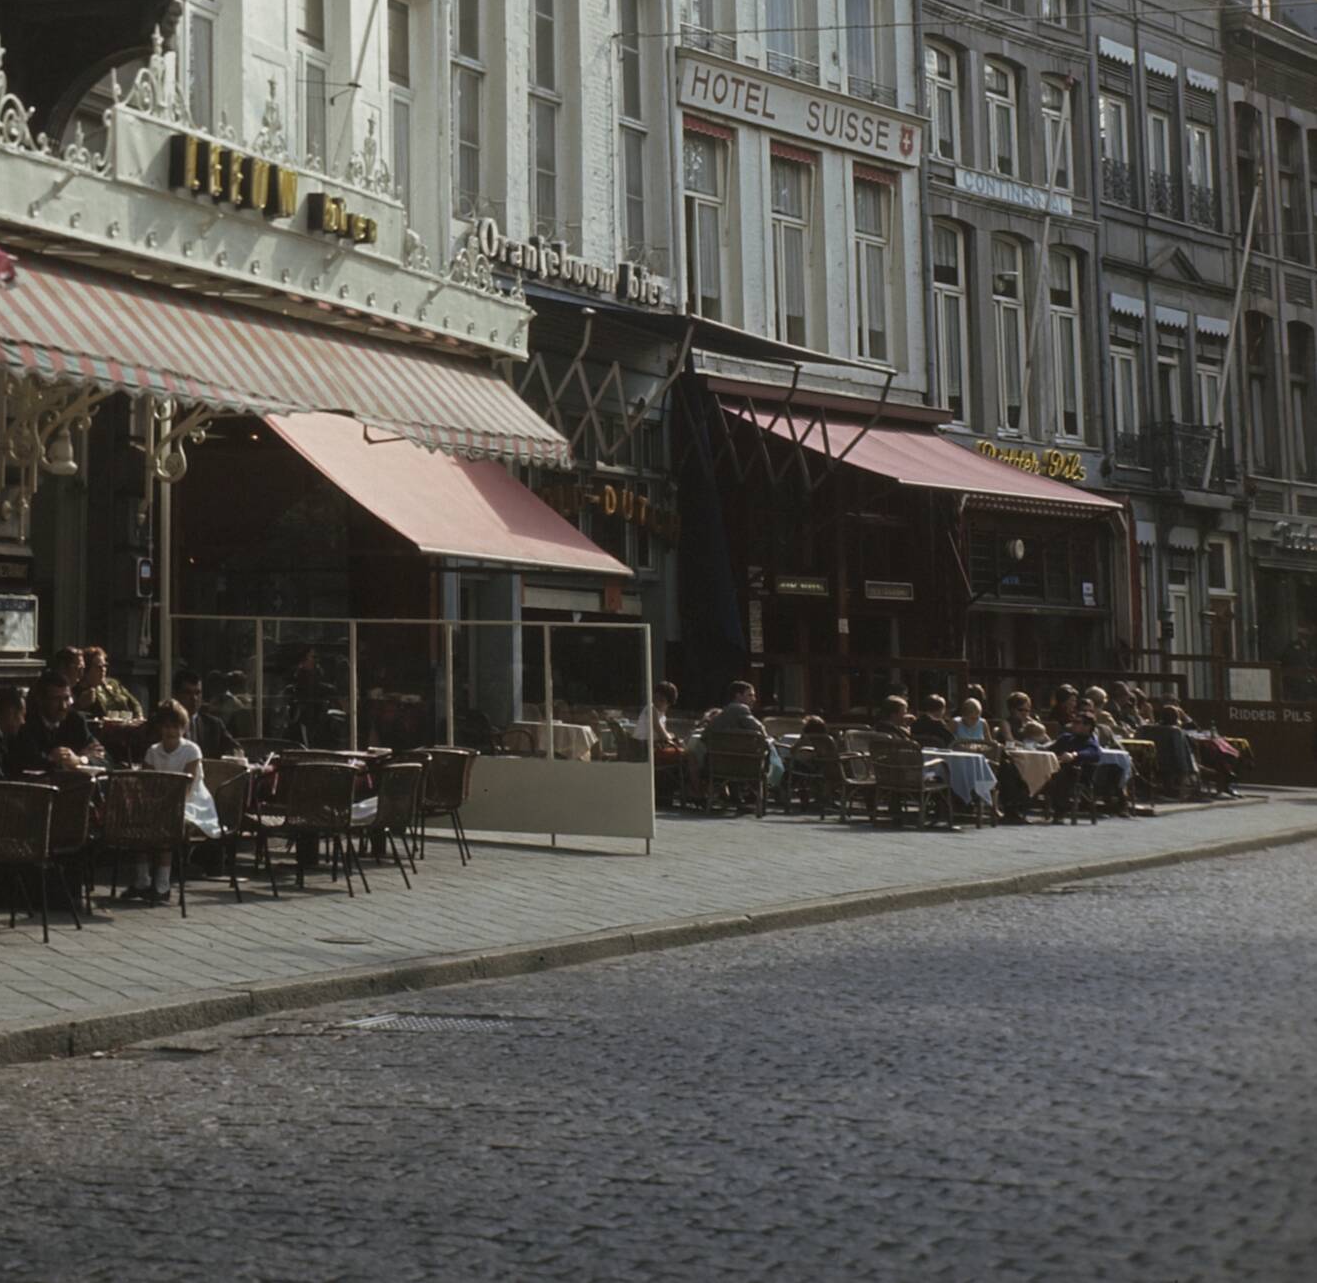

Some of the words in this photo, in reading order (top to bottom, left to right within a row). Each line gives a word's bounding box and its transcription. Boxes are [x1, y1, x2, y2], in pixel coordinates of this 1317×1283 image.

[691, 66, 775, 121] HOTEL
[806, 101, 890, 151] SUISSE
[479, 217, 617, 293] Oranjeboom
[1228, 706, 1277, 722] RIDDER
[1282, 708, 1314, 723] PILS
